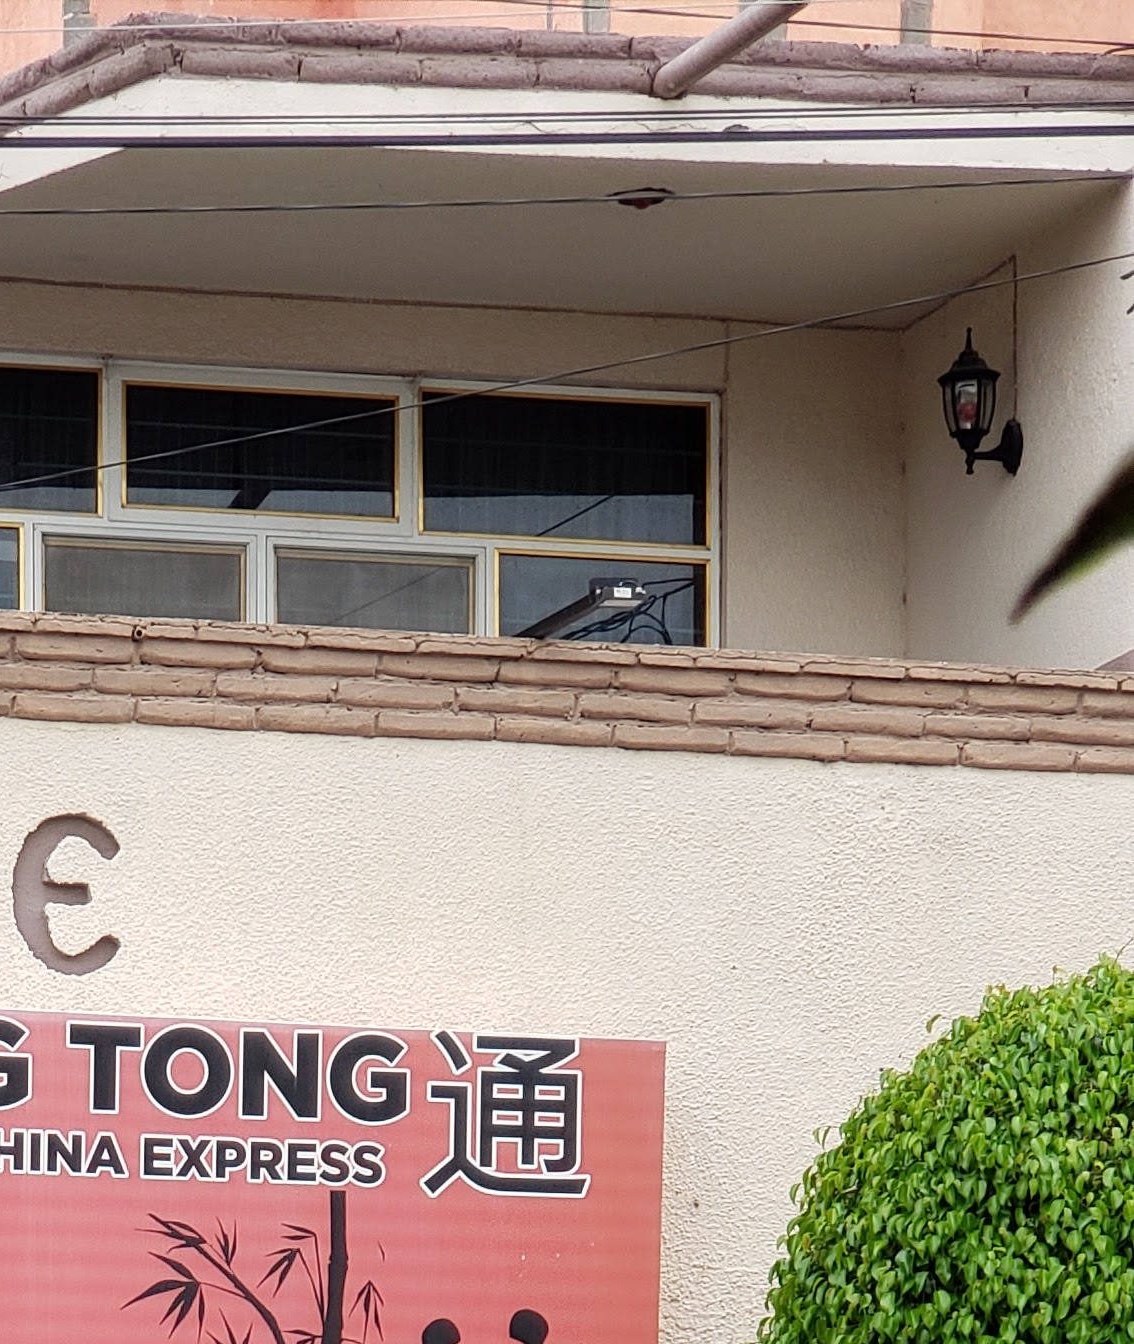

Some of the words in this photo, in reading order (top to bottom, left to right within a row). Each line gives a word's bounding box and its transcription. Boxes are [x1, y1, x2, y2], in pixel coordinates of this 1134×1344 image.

[66, 1021, 410, 1126] TONG
[420, 1029, 591, 1198] 通
[140, 1131, 385, 1187] EXPRESS
